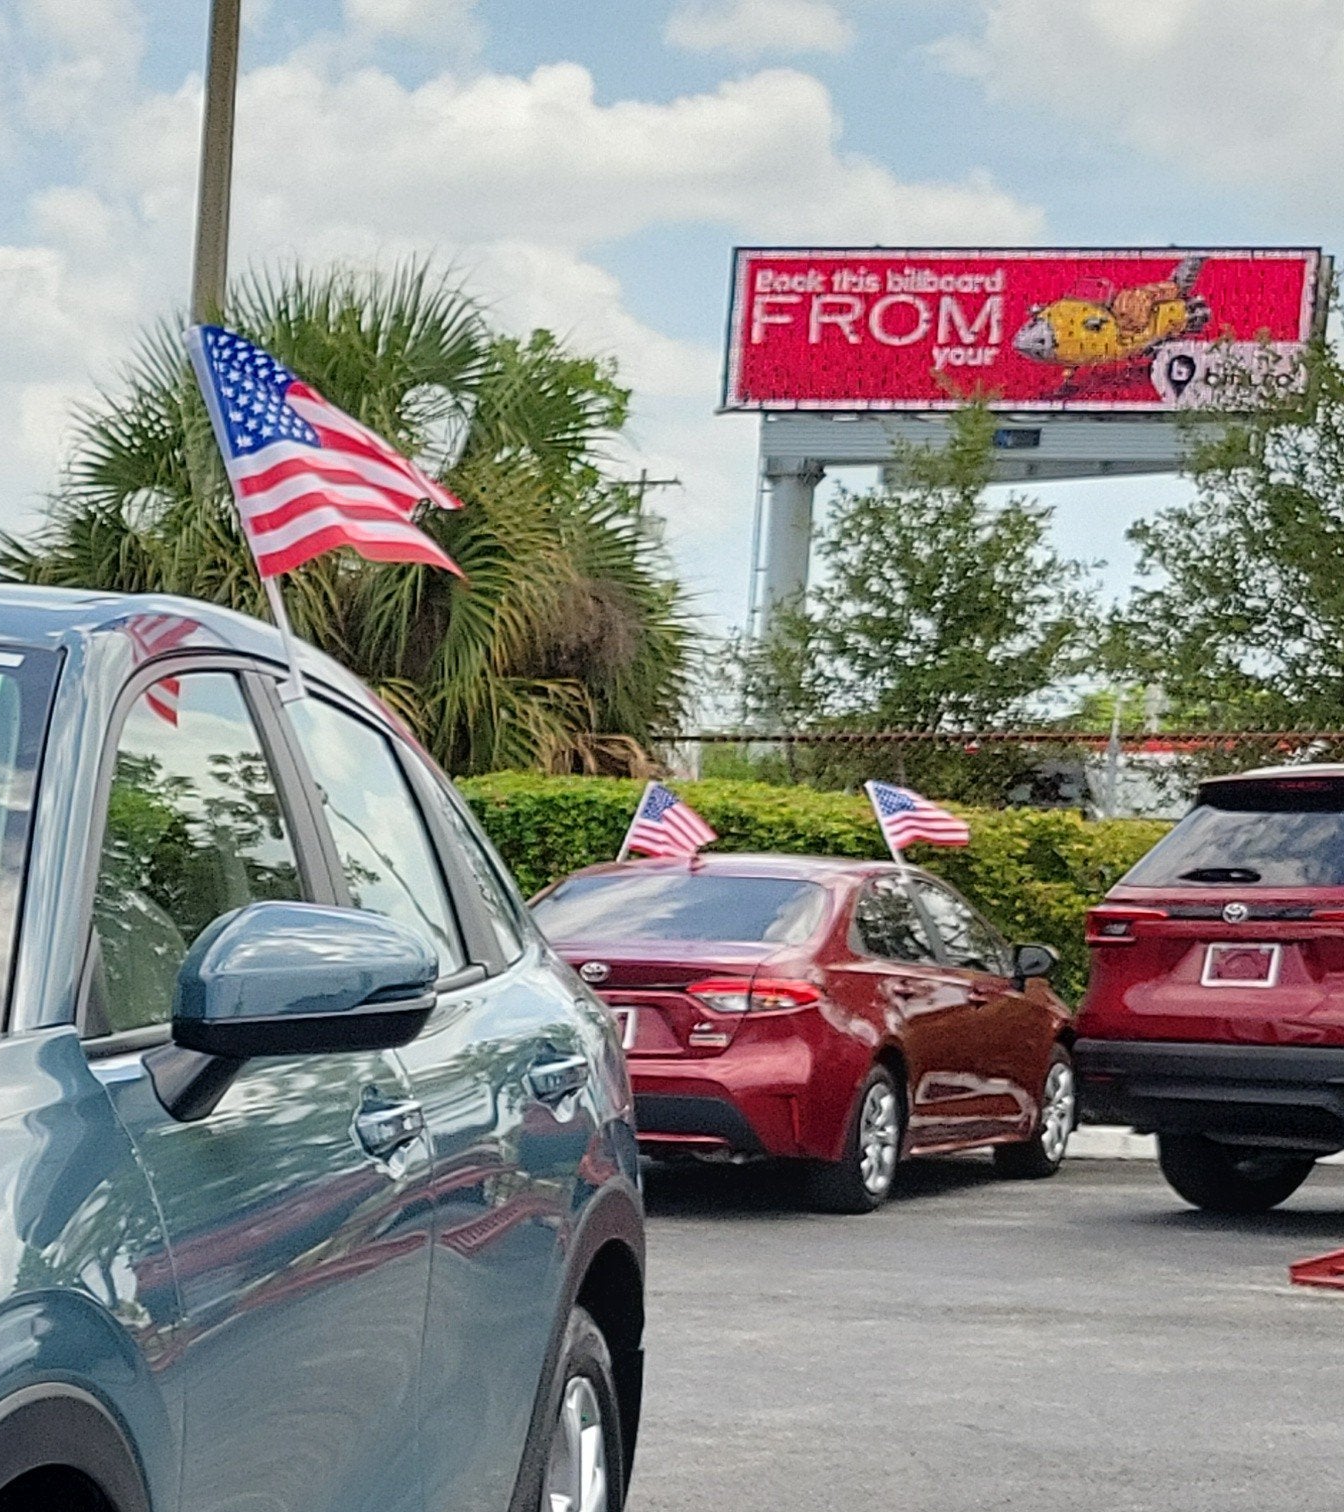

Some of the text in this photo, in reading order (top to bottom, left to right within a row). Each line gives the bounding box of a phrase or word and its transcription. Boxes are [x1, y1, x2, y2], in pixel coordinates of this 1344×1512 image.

[755, 267, 1004, 293] Book this billboard
[751, 294, 1004, 345] FROM
[932, 346, 1000, 370] your
